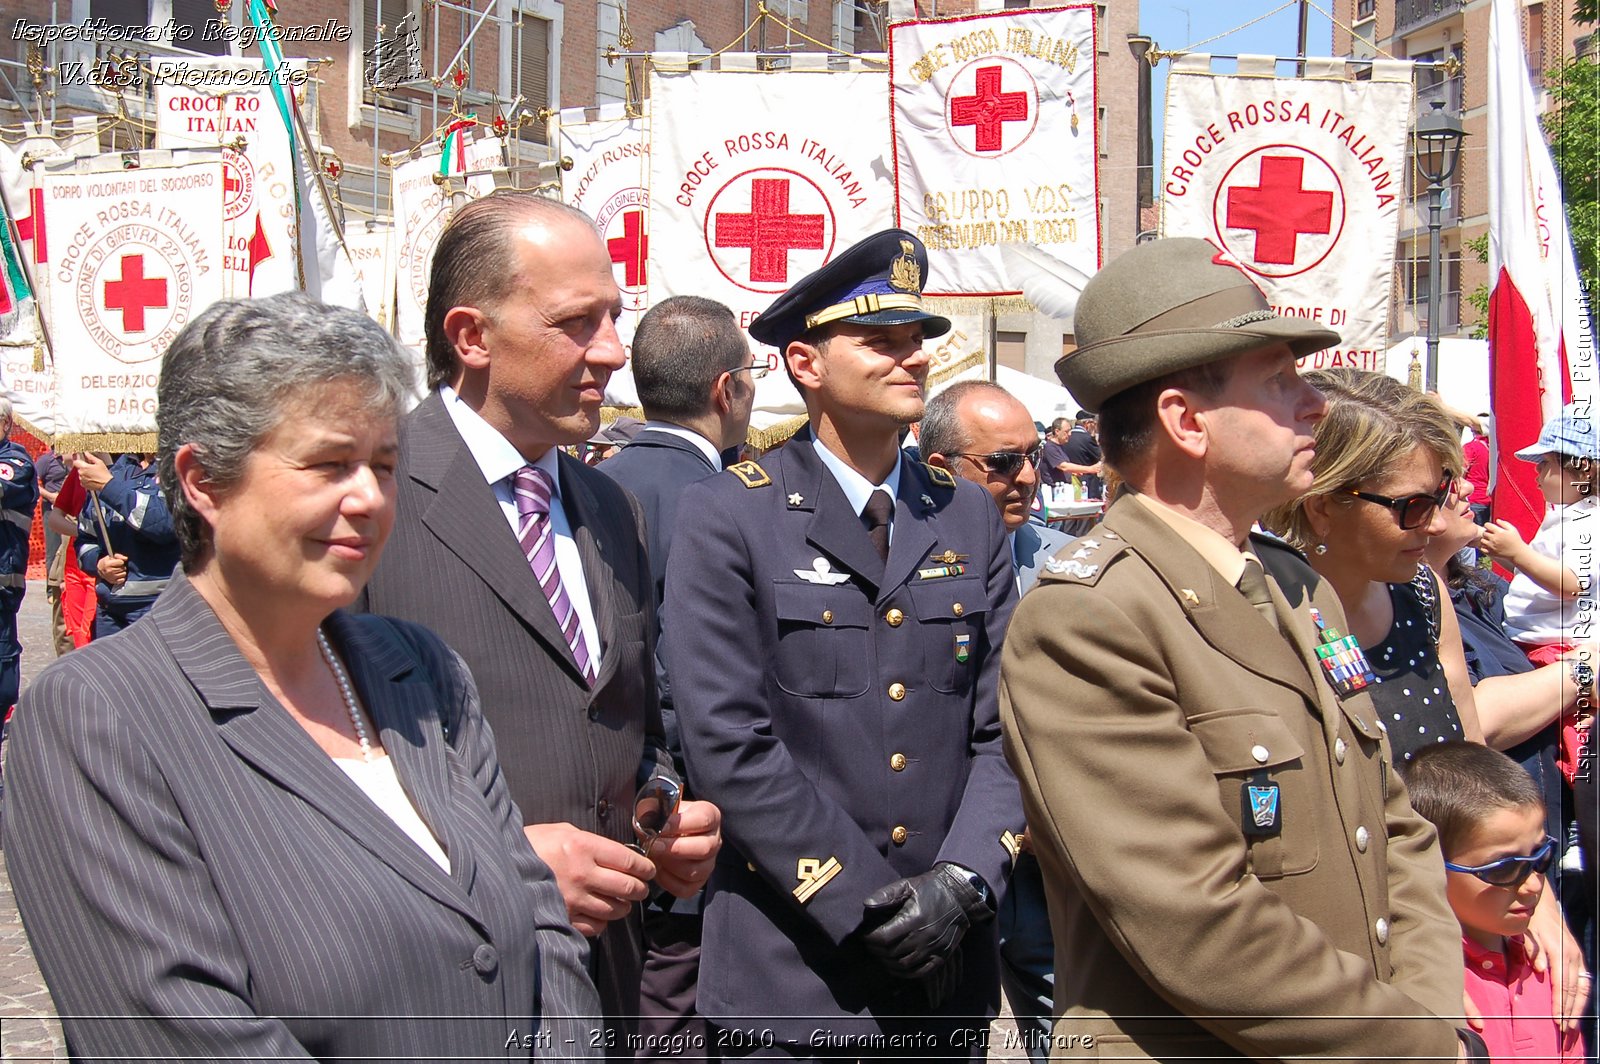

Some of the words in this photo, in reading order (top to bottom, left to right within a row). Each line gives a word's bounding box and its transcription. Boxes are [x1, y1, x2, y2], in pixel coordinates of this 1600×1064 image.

[601, 142, 650, 168] ROSSA
[1166, 123, 1226, 197] CROCE
[1227, 99, 1311, 133] ROSSA
[1320, 108, 1395, 210] ITALIANA
[676, 151, 720, 208] CROCE
[725, 131, 790, 158] ROSSA
[800, 137, 868, 209] ITALIANA
[53, 185, 82, 200] CORPO
[86, 181, 137, 198] VOLONTARI
[139, 179, 158, 194] DEL
[161, 172, 214, 191] SOCCORSO
[607, 201, 616, 216] DI
[923, 188, 1009, 221] GRUPPO
[1024, 183, 1076, 214] V.D.S.
[57, 221, 96, 284] CROCE
[96, 200, 152, 228] ROSSA
[157, 206, 210, 277] ITALIANA
[106, 226, 159, 247] GINEVRA
[160, 240, 179, 259] 22
[91, 245, 107, 263] DI
[174, 261, 191, 326] AGOSTO
[79, 262, 122, 356] CONVENZIONE
[1330, 308, 1347, 326] DI
